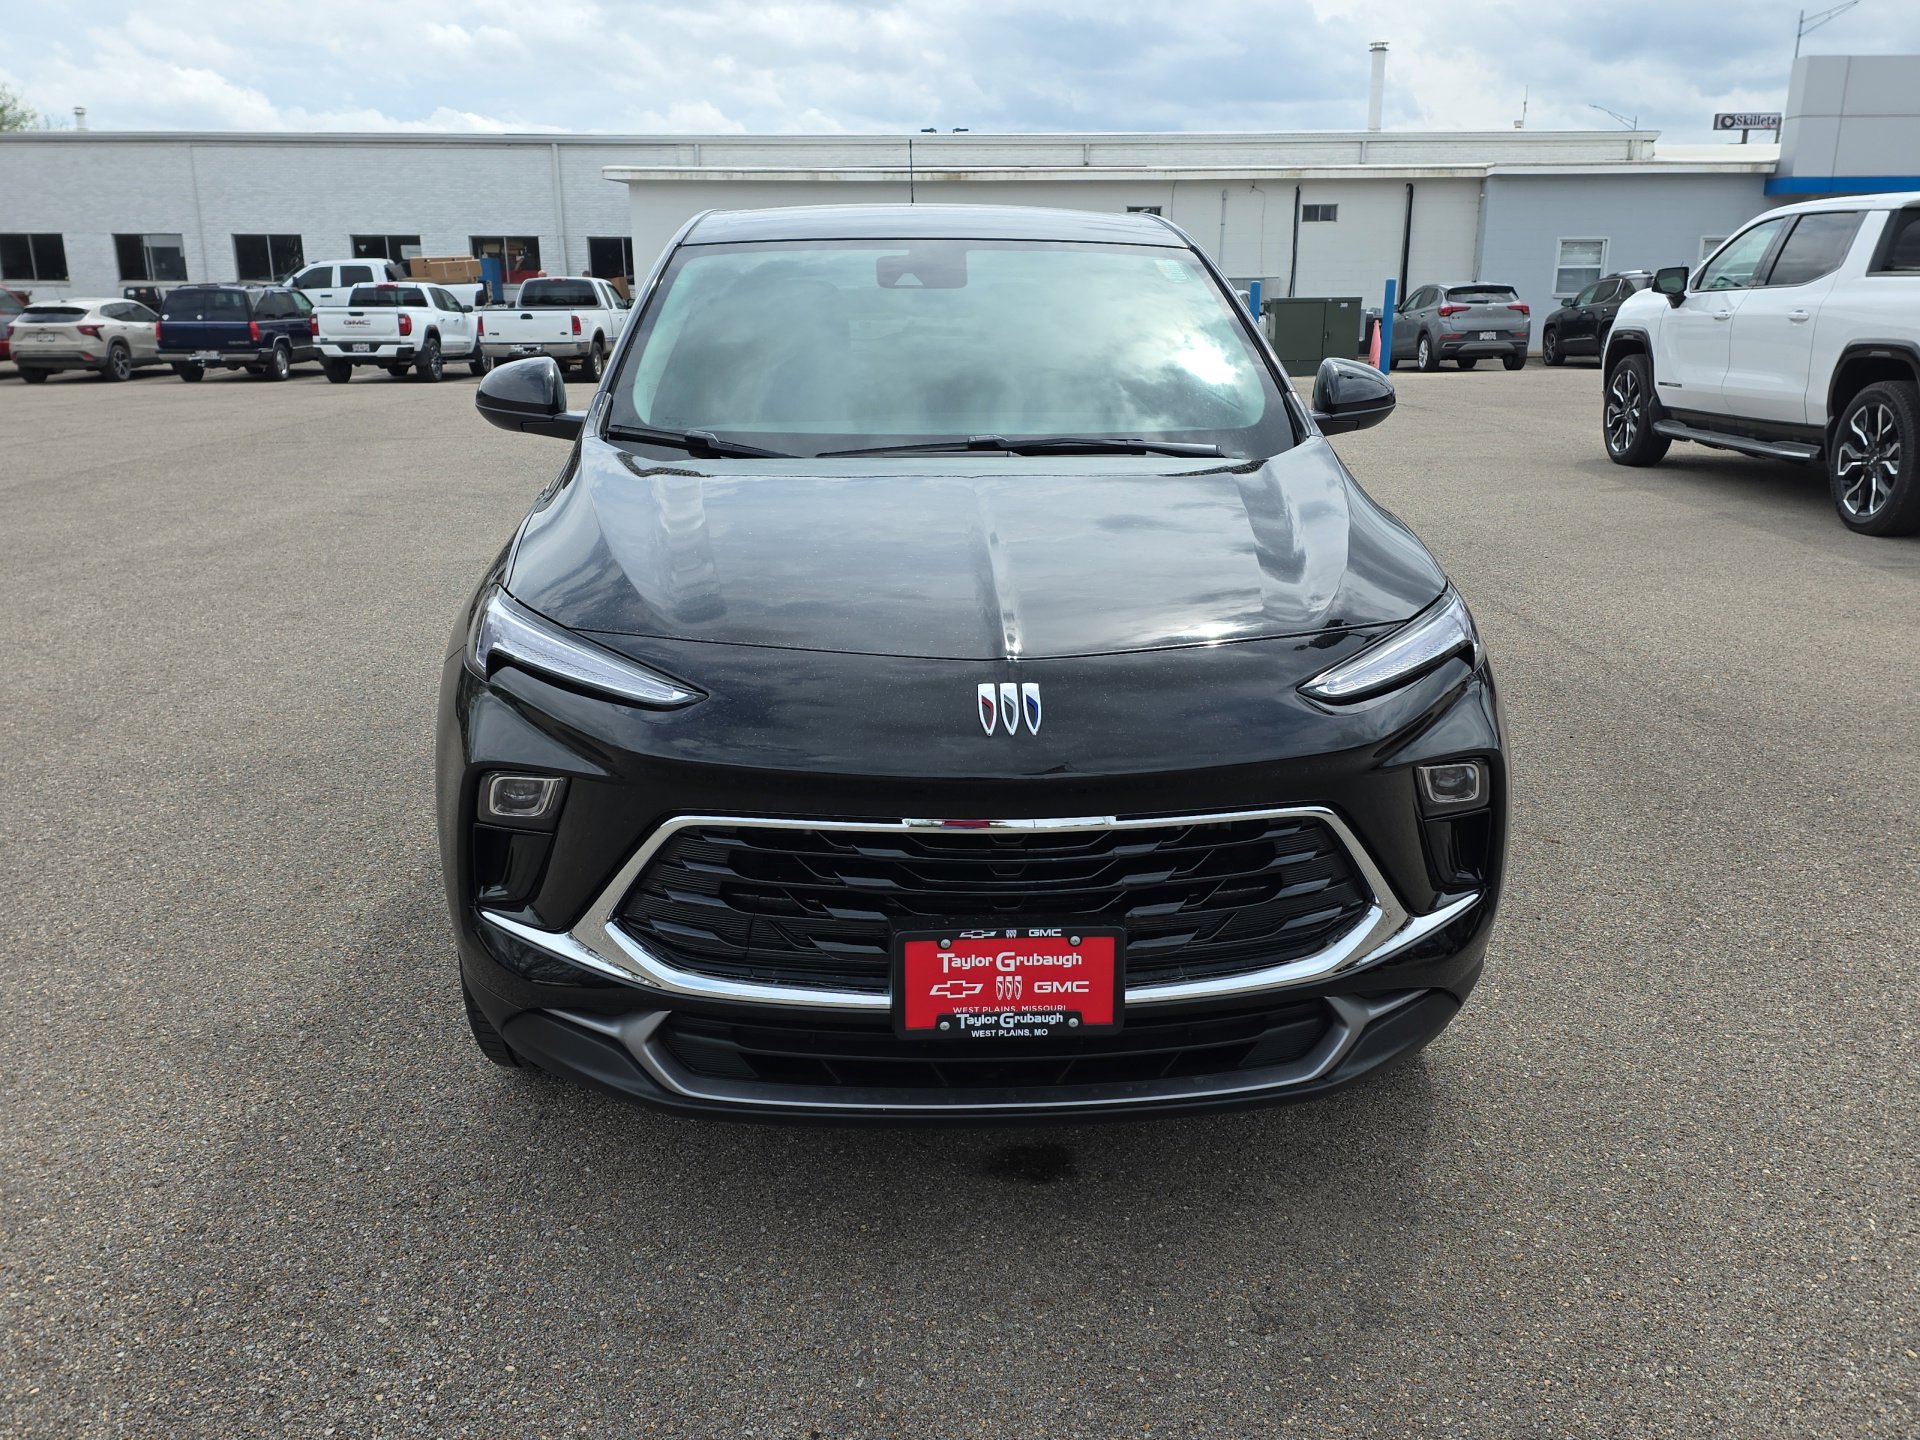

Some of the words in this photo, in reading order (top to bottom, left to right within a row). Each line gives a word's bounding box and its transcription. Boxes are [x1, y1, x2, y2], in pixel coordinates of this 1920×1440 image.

[1736, 115, 1777, 126] Skillets
[1028, 929, 1062, 937] GMC
[936, 952, 993, 974] Taylor
[995, 951, 1082, 972] Grubaugh
[1033, 980, 1090, 993] GMC
[953, 1006, 980, 1014] WEST
[1021, 1004, 1066, 1012] MISSOURI
[956, 1013, 998, 1029] Taylor
[999, 1012, 1064, 1028] Grubaugh
[971, 1029, 997, 1038] WEST
[998, 1028, 1033, 1037] PLAINS,
[1034, 1028, 1048, 1036] MO
